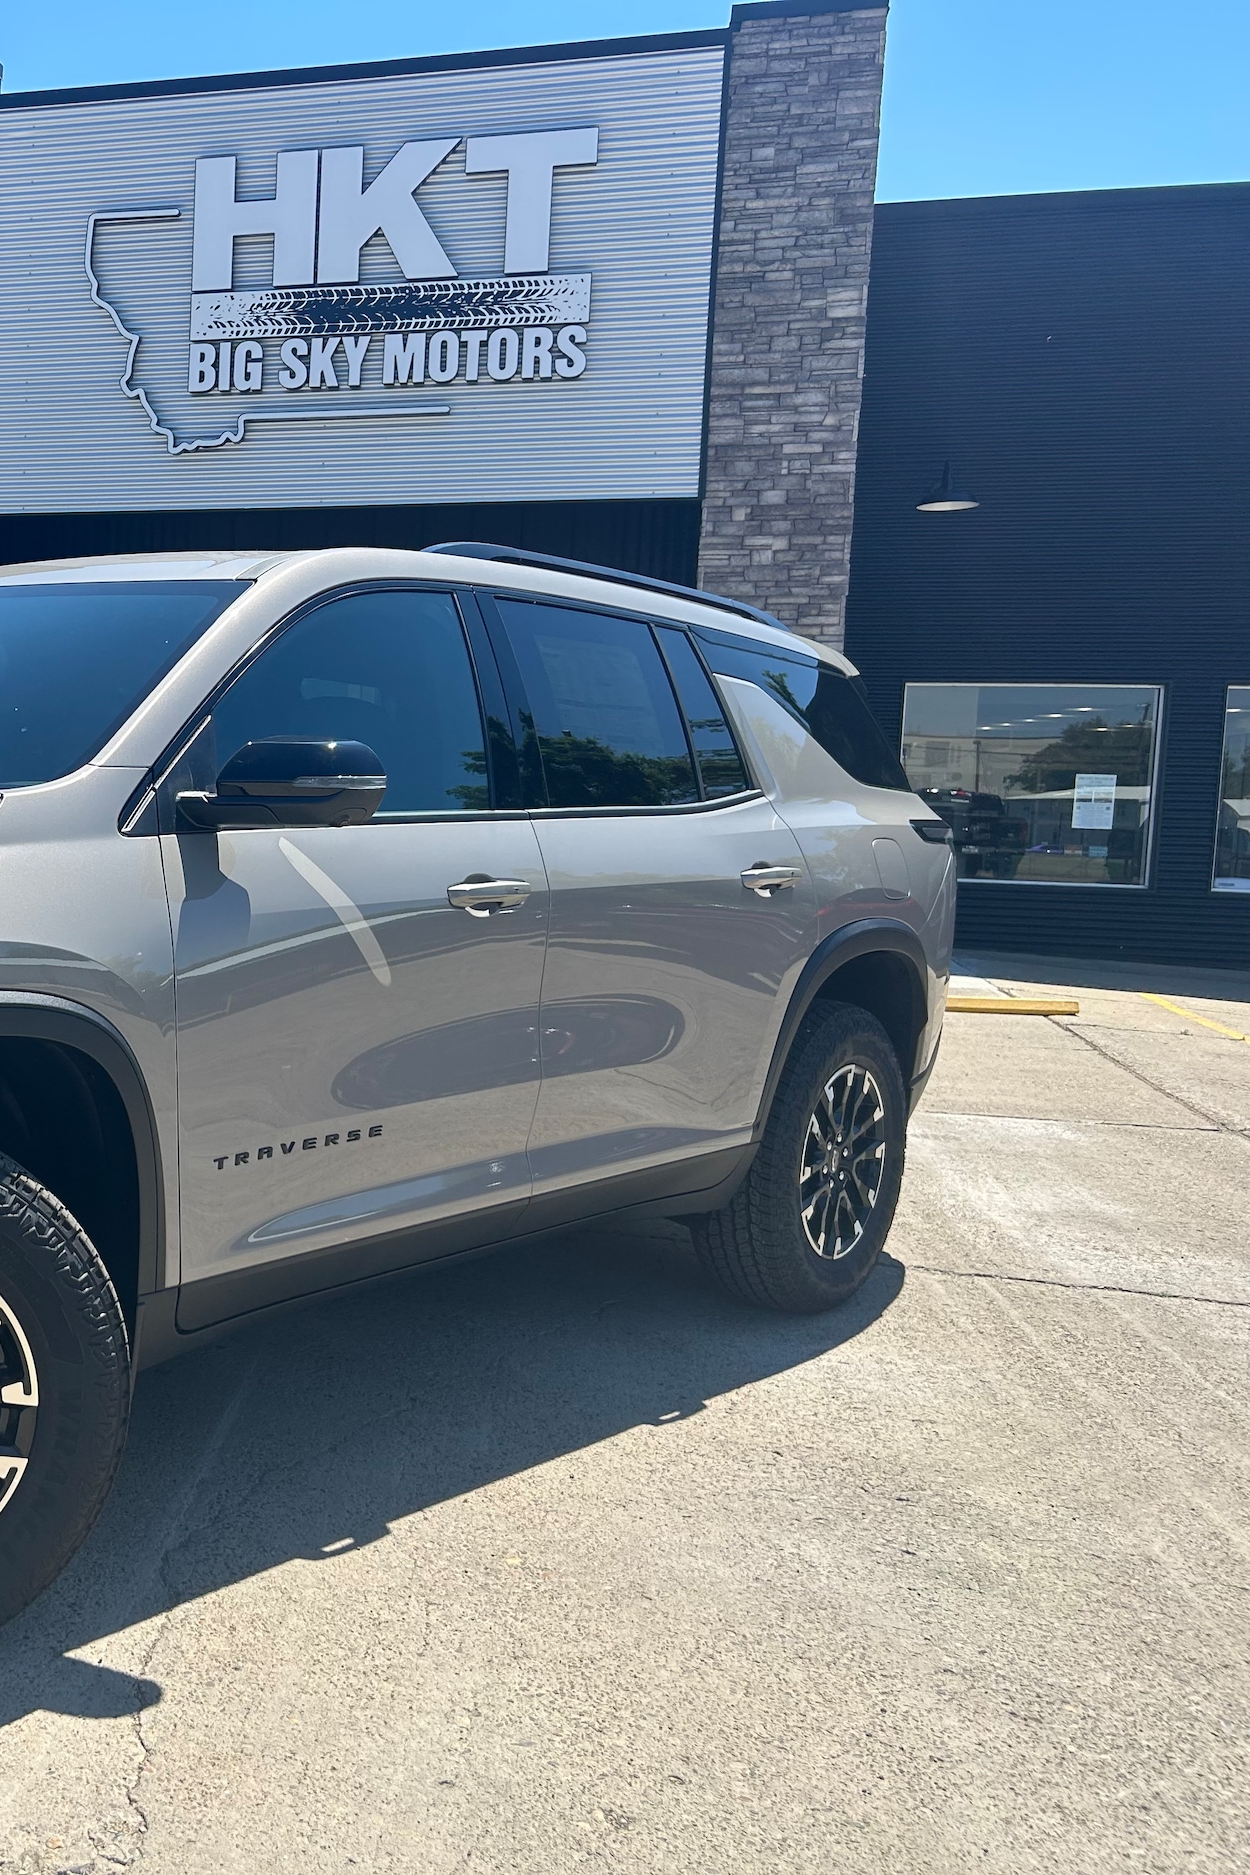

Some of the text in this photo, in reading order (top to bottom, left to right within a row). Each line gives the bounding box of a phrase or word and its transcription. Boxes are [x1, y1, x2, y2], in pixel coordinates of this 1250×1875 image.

[191, 127, 599, 292] HKT
[188, 325, 587, 393] BIG SKY MOTORS
[213, 1125, 383, 1170] TRAVERSE
